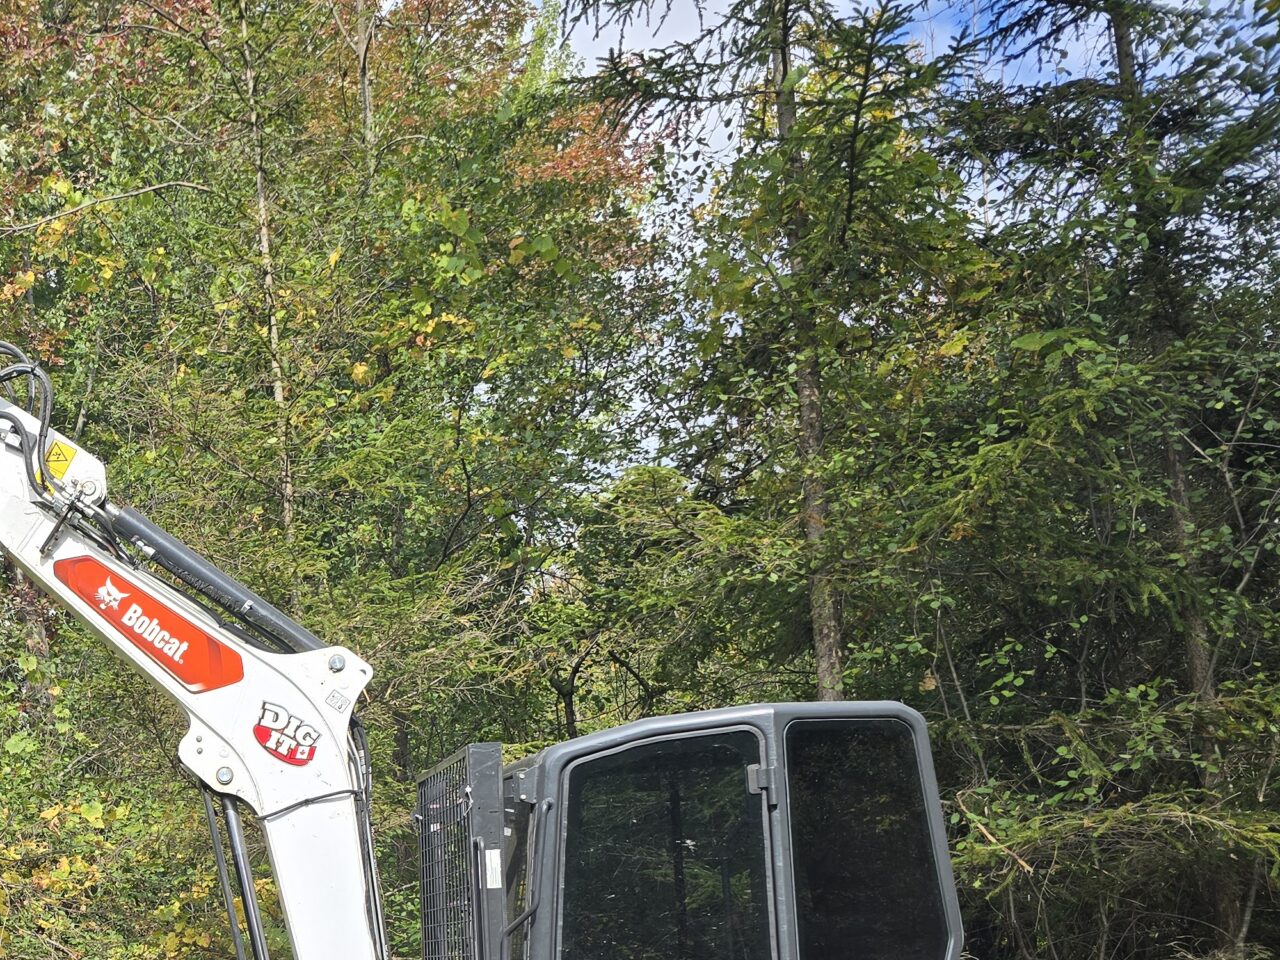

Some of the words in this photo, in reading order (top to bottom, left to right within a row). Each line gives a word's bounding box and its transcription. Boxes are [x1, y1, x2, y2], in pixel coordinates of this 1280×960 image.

[121, 603, 189, 662] Bobcat
[258, 700, 322, 747] DIG
[265, 730, 299, 757] IT
